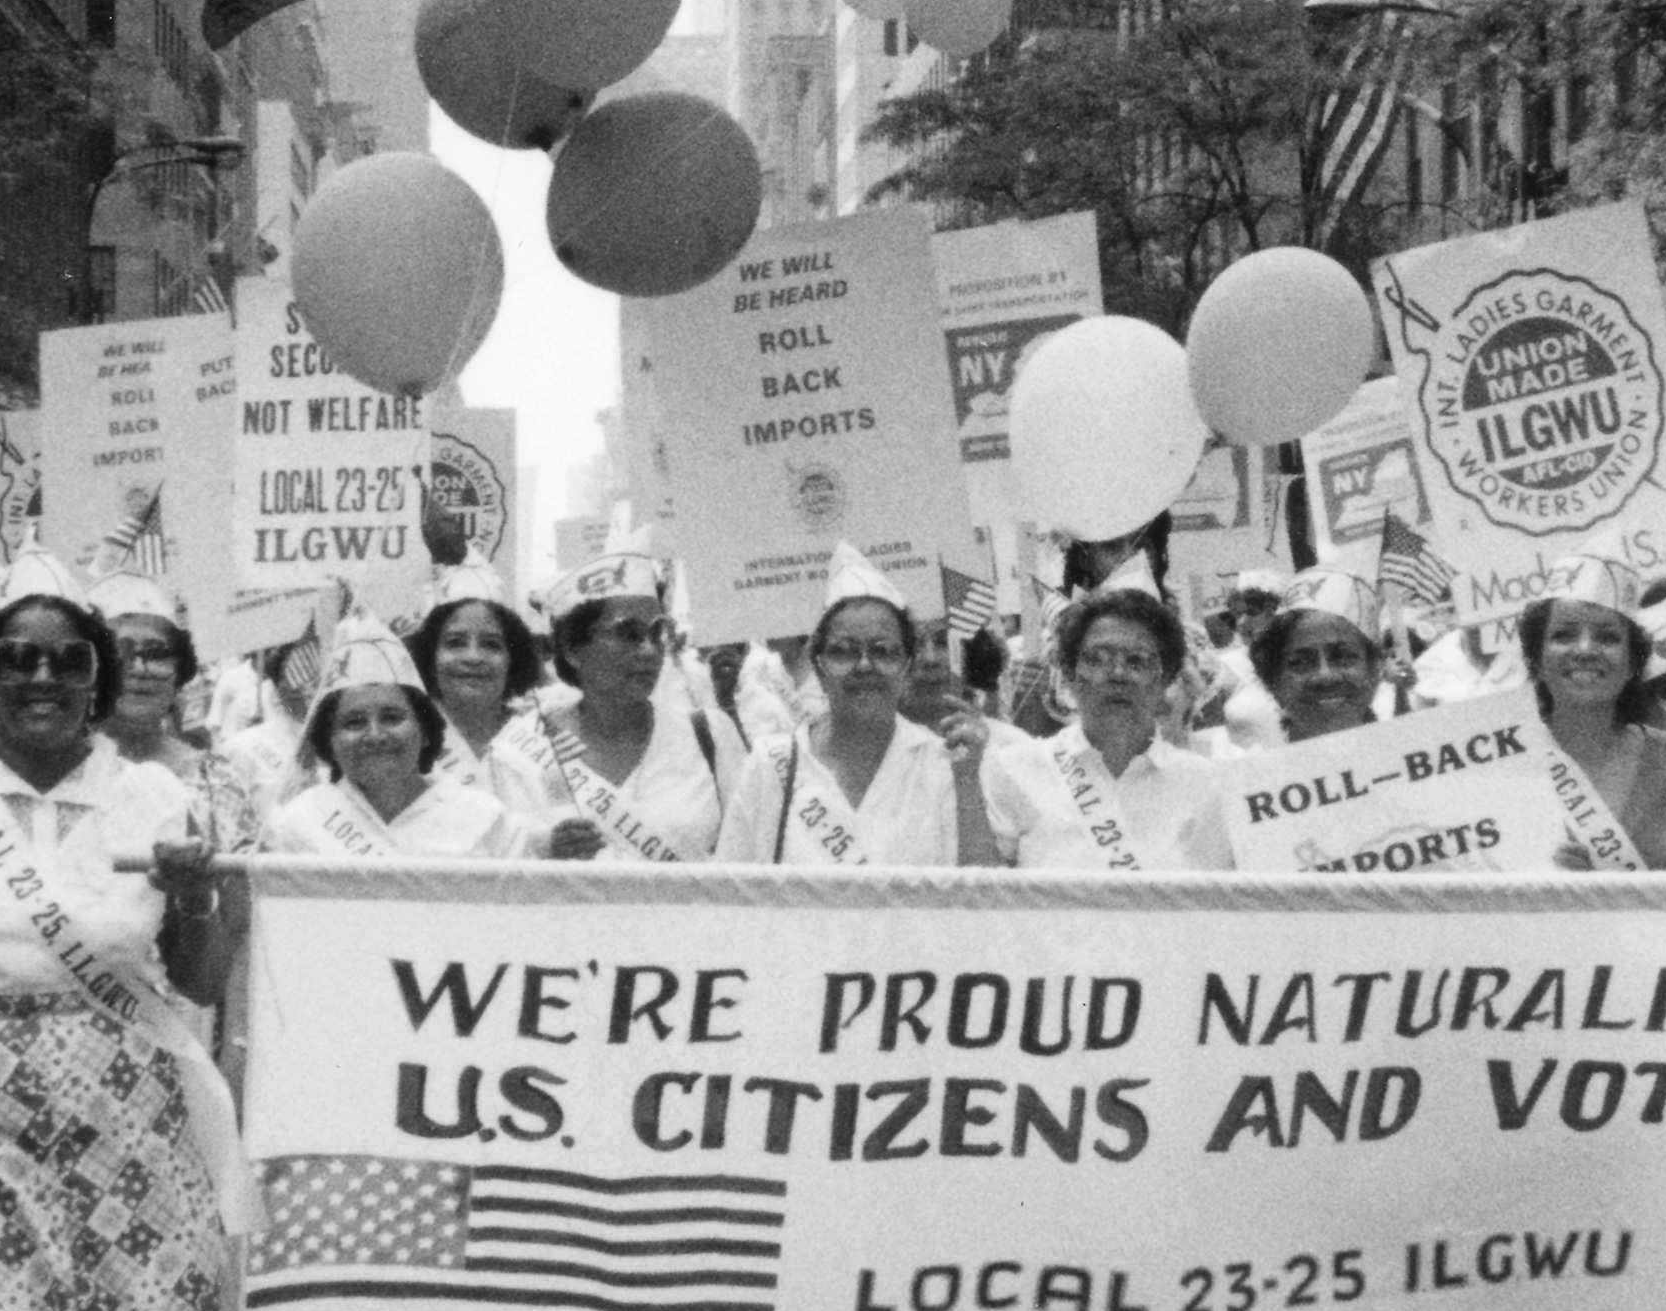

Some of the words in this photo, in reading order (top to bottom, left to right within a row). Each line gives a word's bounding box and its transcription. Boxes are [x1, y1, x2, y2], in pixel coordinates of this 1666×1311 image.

[739, 259, 774, 282] WE
[781, 251, 834, 275] WILL
[733, 291, 762, 314] BE
[768, 280, 849, 308] HEARD
[758, 324, 833, 354] ROLL
[1445, 292, 1529, 367] LADIES
[1535, 289, 1647, 385] GARMENT
[1475, 332, 1589, 377] UNION
[761, 366, 843, 398] BACK
[960, 350, 1007, 388] NY
[1486, 357, 1590, 401] MADE
[243, 399, 293, 435] NOT
[307, 395, 424, 433] WELFARE
[743, 407, 876, 446] IMPORTS
[1477, 386, 1623, 464] ILGWU
[1334, 467, 1368, 495] NY
[1458, 449, 1585, 517] WORKERS
[1589, 408, 1649, 501] UNION
[1522, 450, 1597, 485] AFL-CIO
[259, 466, 330, 516] LOCAL
[336, 466, 406, 513] 23-25
[254, 524, 408, 564] ILGWU
[1469, 552, 1547, 611] Mad
[1053, 749, 1101, 817] LOCAL
[388, 957, 751, 1047] WE'RE
[817, 969, 1145, 1057] PROUD
[393, 1061, 577, 1150] U.S.
[631, 1071, 1152, 1165] CITIZENS
[1202, 1064, 1424, 1154] AND
[1404, 1229, 1635, 1295] ILGWU
